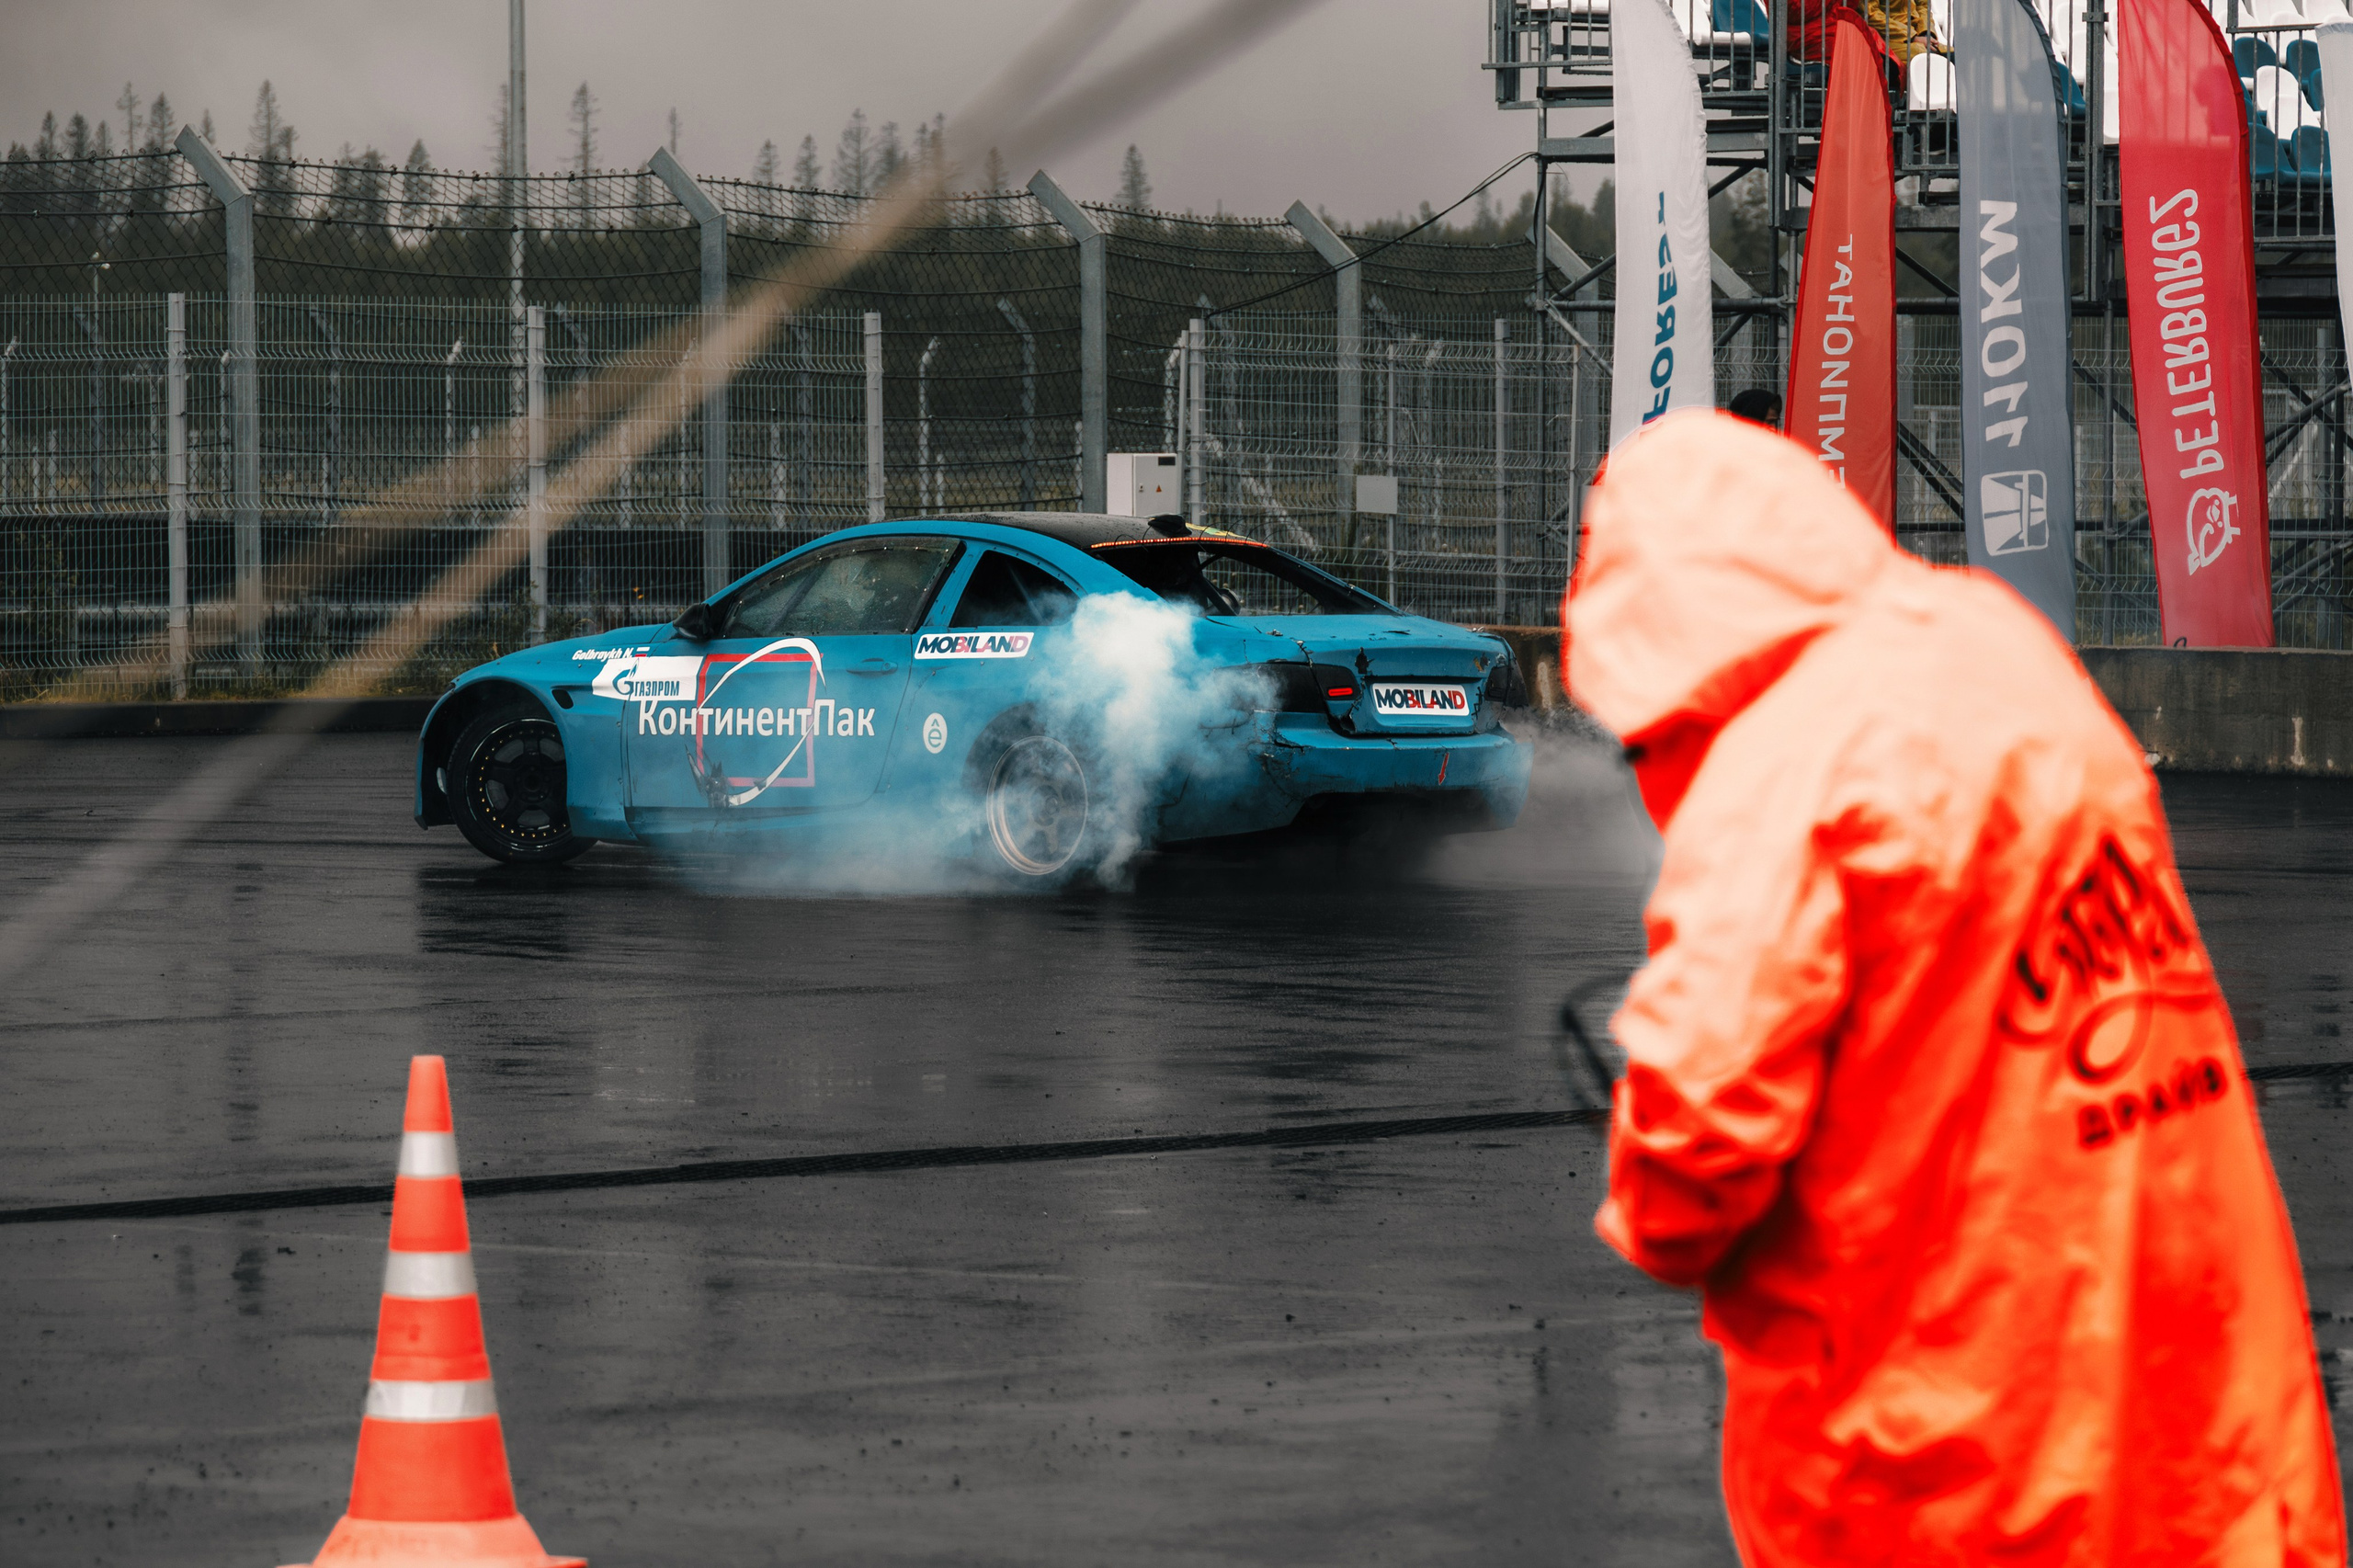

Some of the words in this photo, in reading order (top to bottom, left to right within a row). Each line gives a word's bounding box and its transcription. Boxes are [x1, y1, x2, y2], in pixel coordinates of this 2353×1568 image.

[917, 635, 1029, 653] MOBILAND
[572, 647, 623, 662] Golbraykh
[622, 647, 634, 658] N.
[634, 680, 680, 697] ГАЗПРОМ
[1375, 688, 1466, 710] MOBILAND
[639, 699, 876, 736] КонтинентПак
